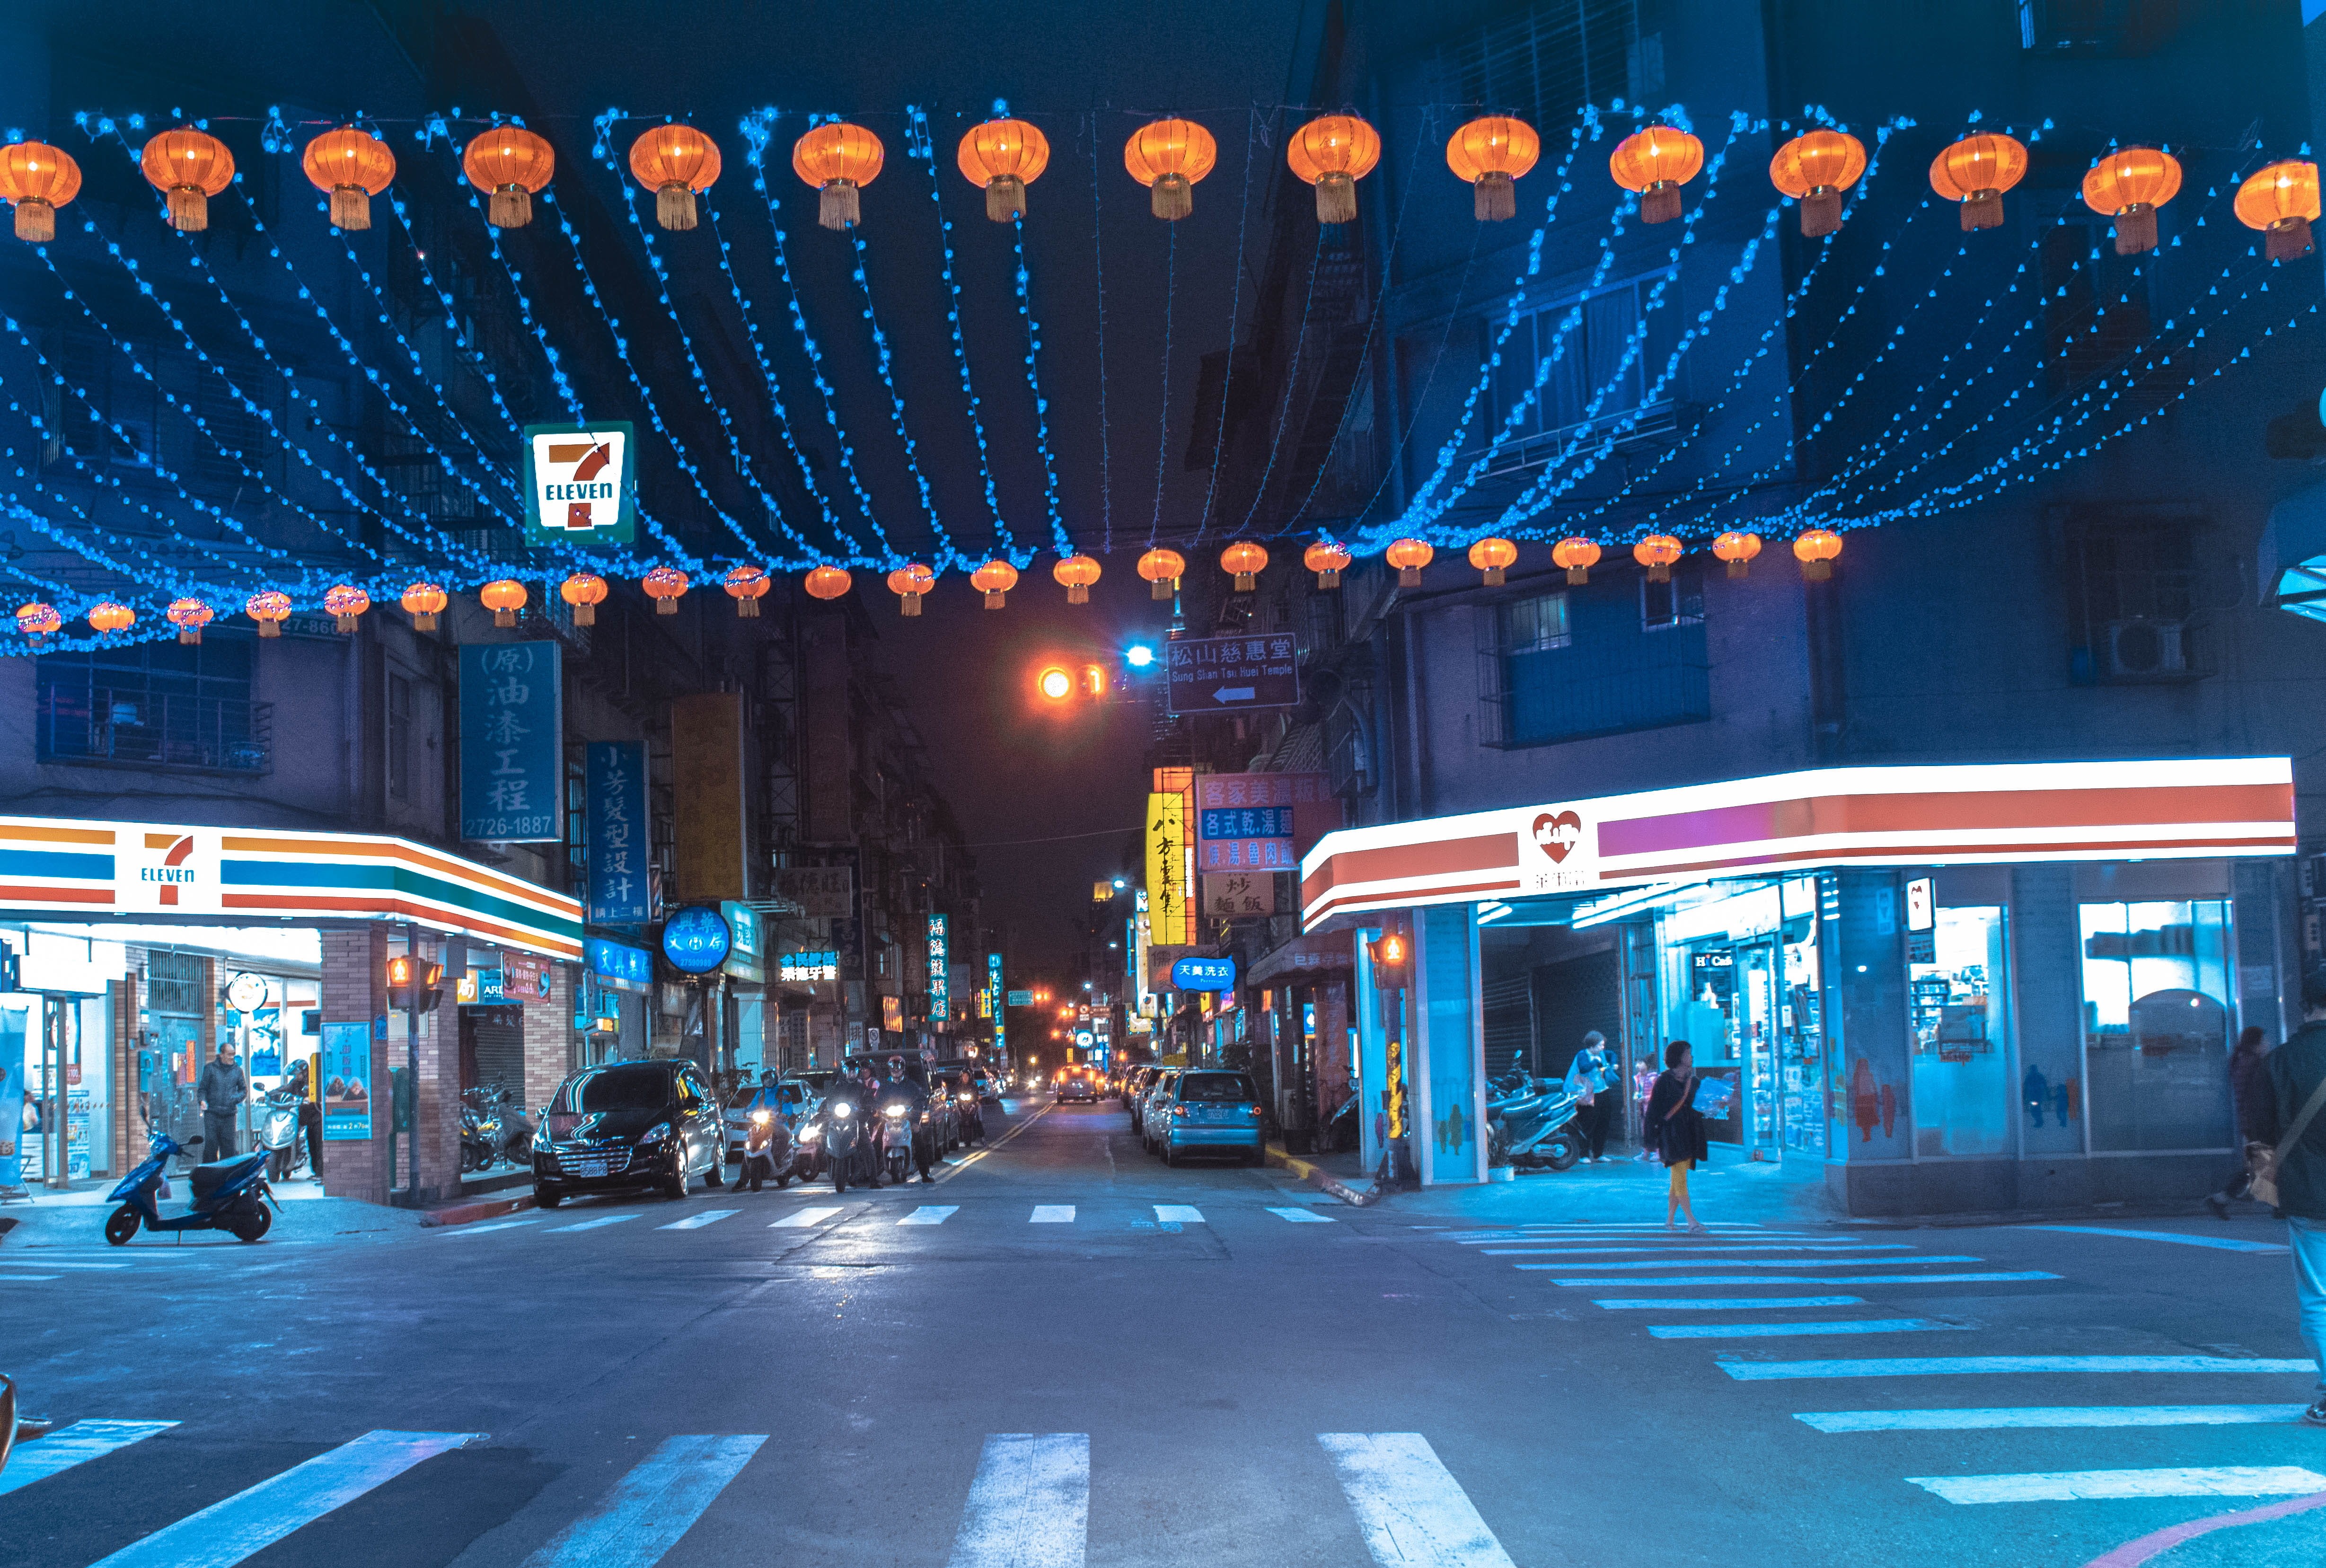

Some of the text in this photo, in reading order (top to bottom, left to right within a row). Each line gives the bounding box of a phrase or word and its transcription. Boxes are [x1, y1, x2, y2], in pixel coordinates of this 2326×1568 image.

[548, 442, 610, 528] 7
[1171, 639, 1292, 666] 松山慈惠堂
[1172, 671, 1193, 682] Sung
[1197, 669, 1218, 680] Shan
[1240, 666, 1259, 677] Huei
[1261, 664, 1293, 676] Temple
[465, 816, 551, 837] 2726-1887
[599, 746, 634, 904] 小芳髮型設計
[145, 833, 193, 906] 7
[929, 919, 947, 1017] 福德蔬果店
